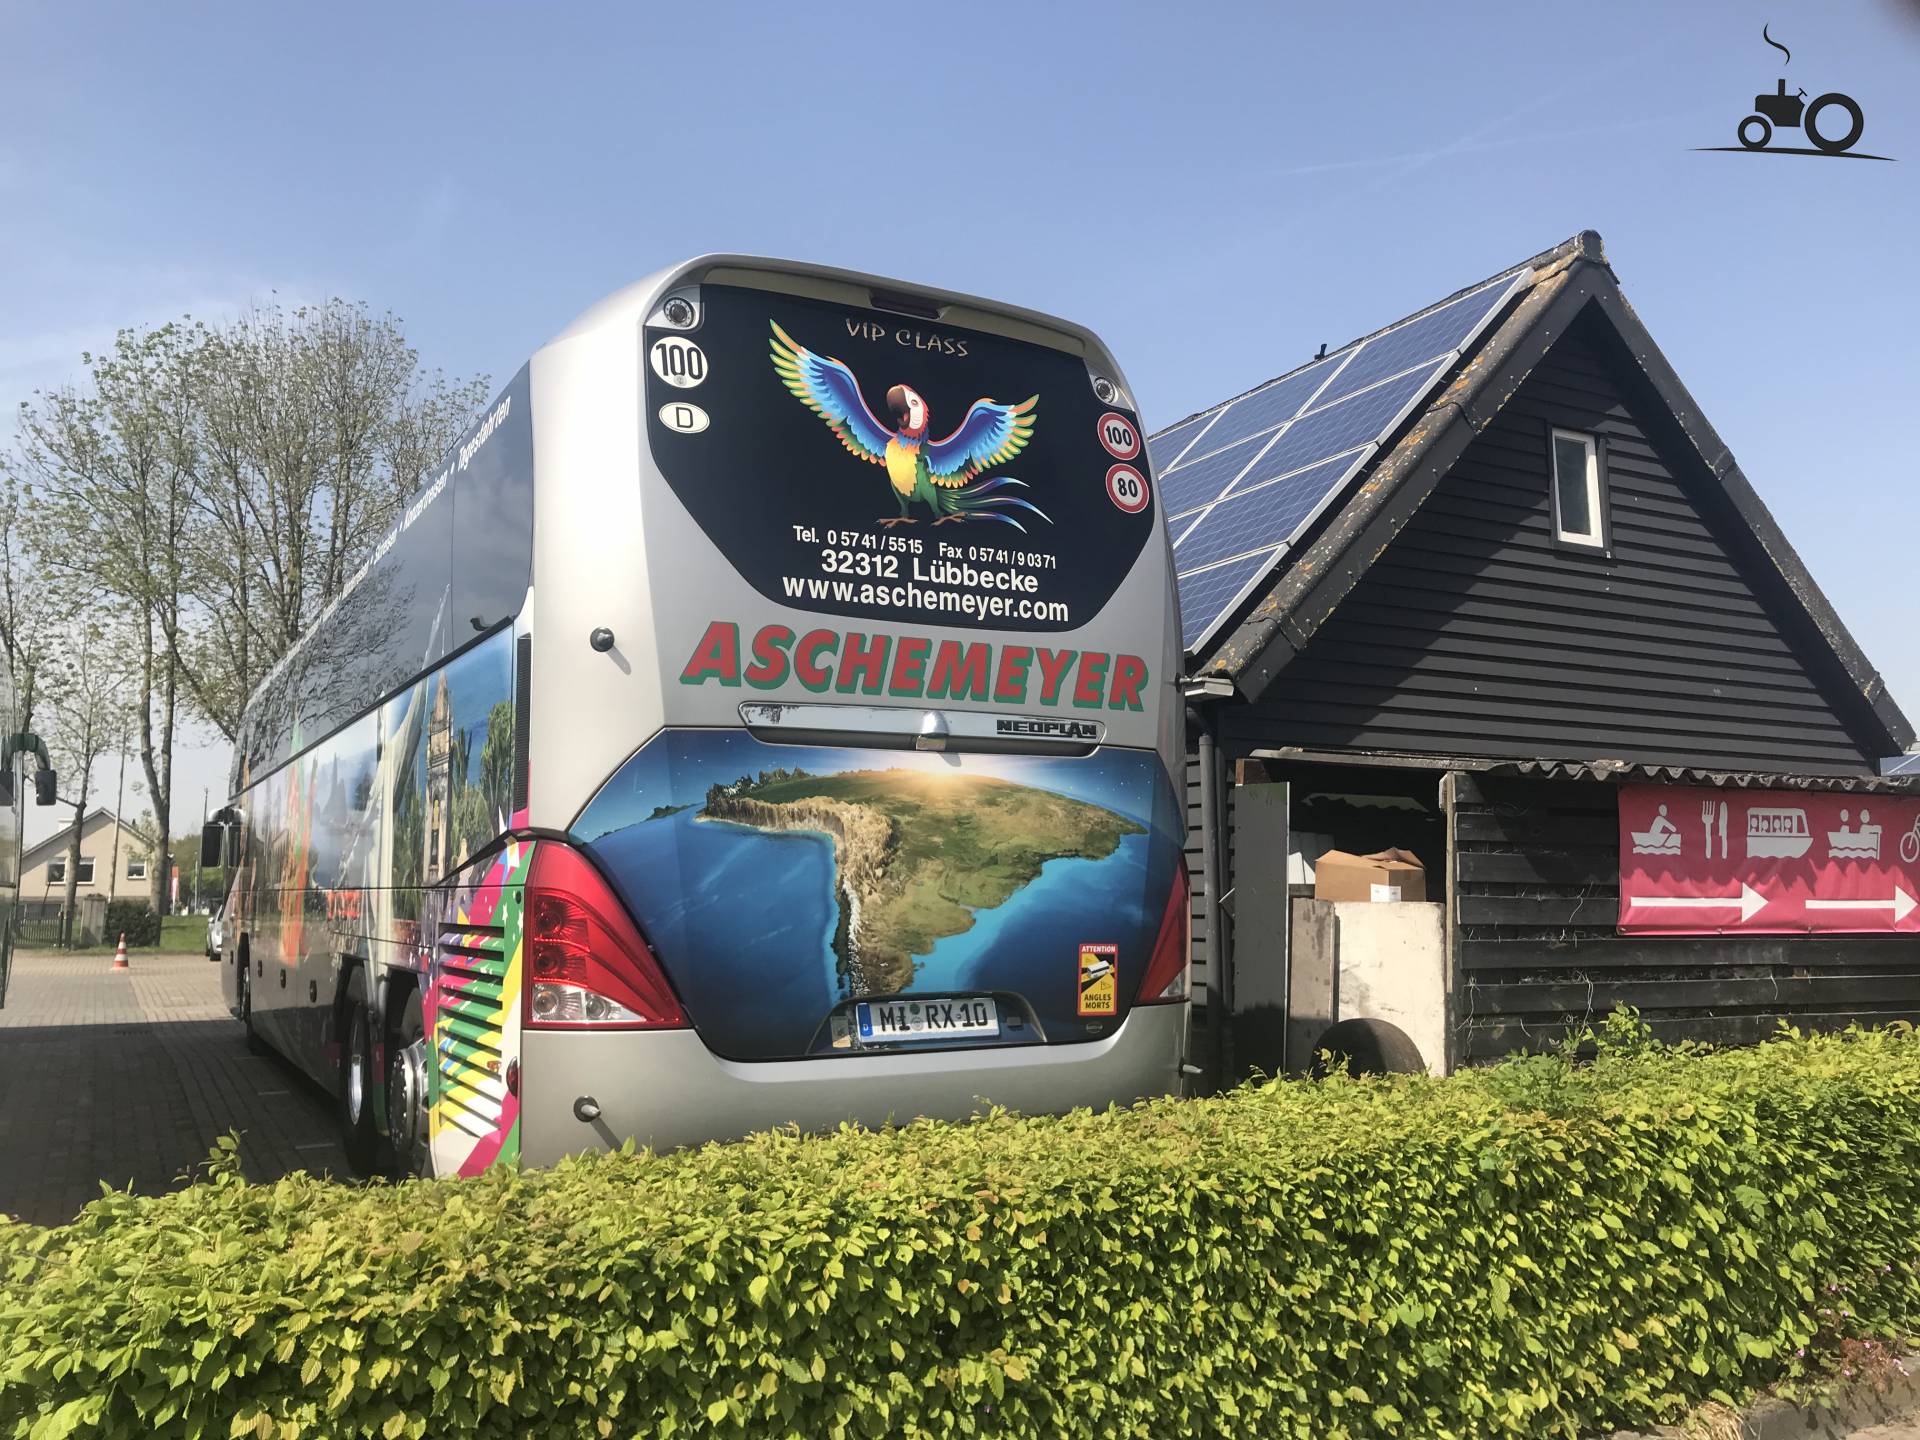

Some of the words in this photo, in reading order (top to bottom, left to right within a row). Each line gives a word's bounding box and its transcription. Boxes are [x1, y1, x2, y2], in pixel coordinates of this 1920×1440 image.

[845, 318, 886, 341] VIP
[895, 329, 969, 357] CLASS
[655, 343, 704, 380] 100
[675, 406, 694, 429] D
[1105, 425, 1133, 447] 100
[1117, 477, 1139, 498] 80
[792, 525, 820, 544] Tel.
[939, 541, 963, 559] Fax
[821, 549, 899, 579] 32312
[913, 557, 1039, 593] Lübbecke
[782, 576, 1069, 622] www.aschemeyer.com
[679, 620, 1150, 712] ASCHEMEYER
[996, 719, 1097, 739] NEOPLAN
[1081, 945, 1116, 954] ATTENTION
[1084, 993, 1112, 1001] ANGLES
[1085, 1001, 1110, 1009] MORTS
